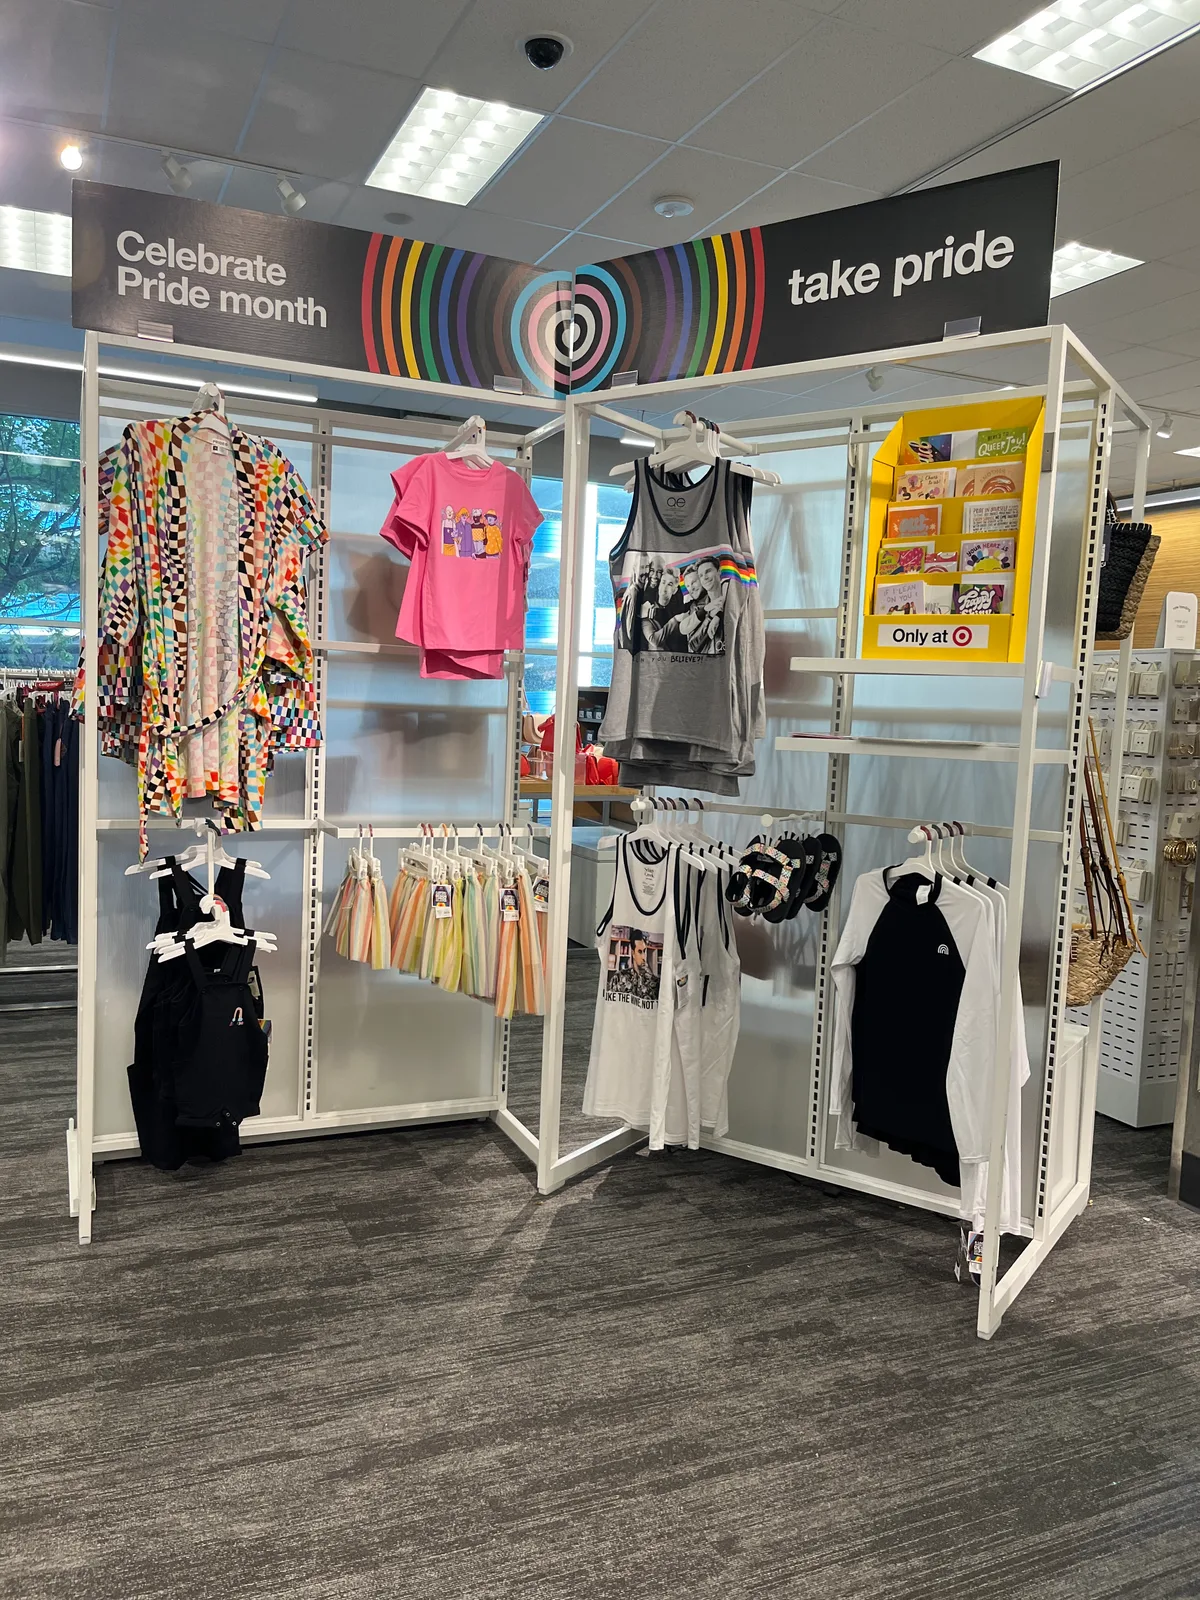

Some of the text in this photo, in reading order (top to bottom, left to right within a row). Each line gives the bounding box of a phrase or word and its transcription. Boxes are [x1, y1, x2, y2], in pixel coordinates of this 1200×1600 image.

[116, 230, 287, 286] Celebrate
[788, 229, 1015, 306] take pride
[117, 265, 328, 328] Pride month
[978, 441, 1006, 457] QUEER
[966, 544, 981, 557] YOUR
[884, 589, 889, 597] IF
[898, 583, 916, 595] LEAN
[900, 592, 912, 601] YOU
[892, 628, 949, 646] Only at
[617, 992, 630, 1003] THE
[642, 1000, 655, 1009] NOT
